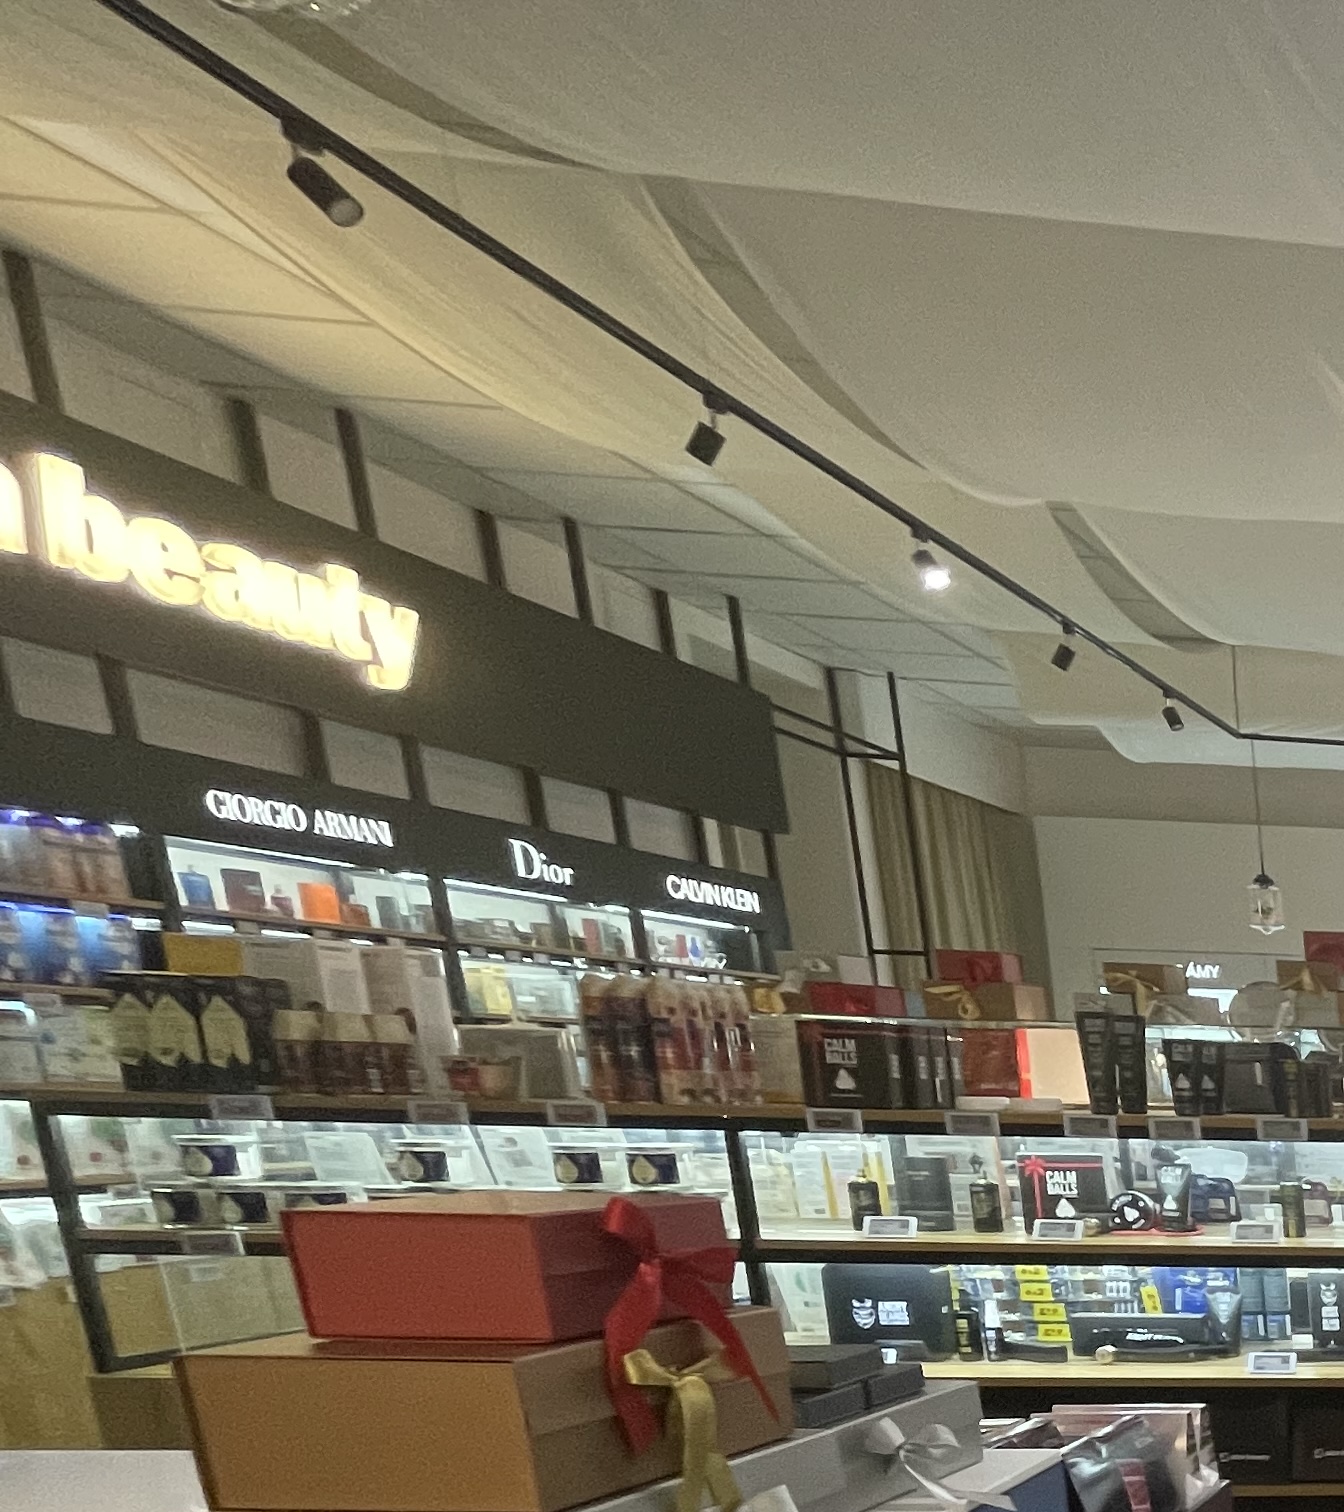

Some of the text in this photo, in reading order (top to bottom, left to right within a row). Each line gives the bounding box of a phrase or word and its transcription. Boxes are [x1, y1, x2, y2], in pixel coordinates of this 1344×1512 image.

[37, 451, 421, 691] beauty
[205, 788, 395, 849] GIORGIO ARMANI
[508, 837, 575, 887] Dior
[665, 874, 761, 914] CALVIN KLEIN
[1045, 1170, 1077, 1184] CALM
[1047, 1183, 1079, 1195] BALLS
